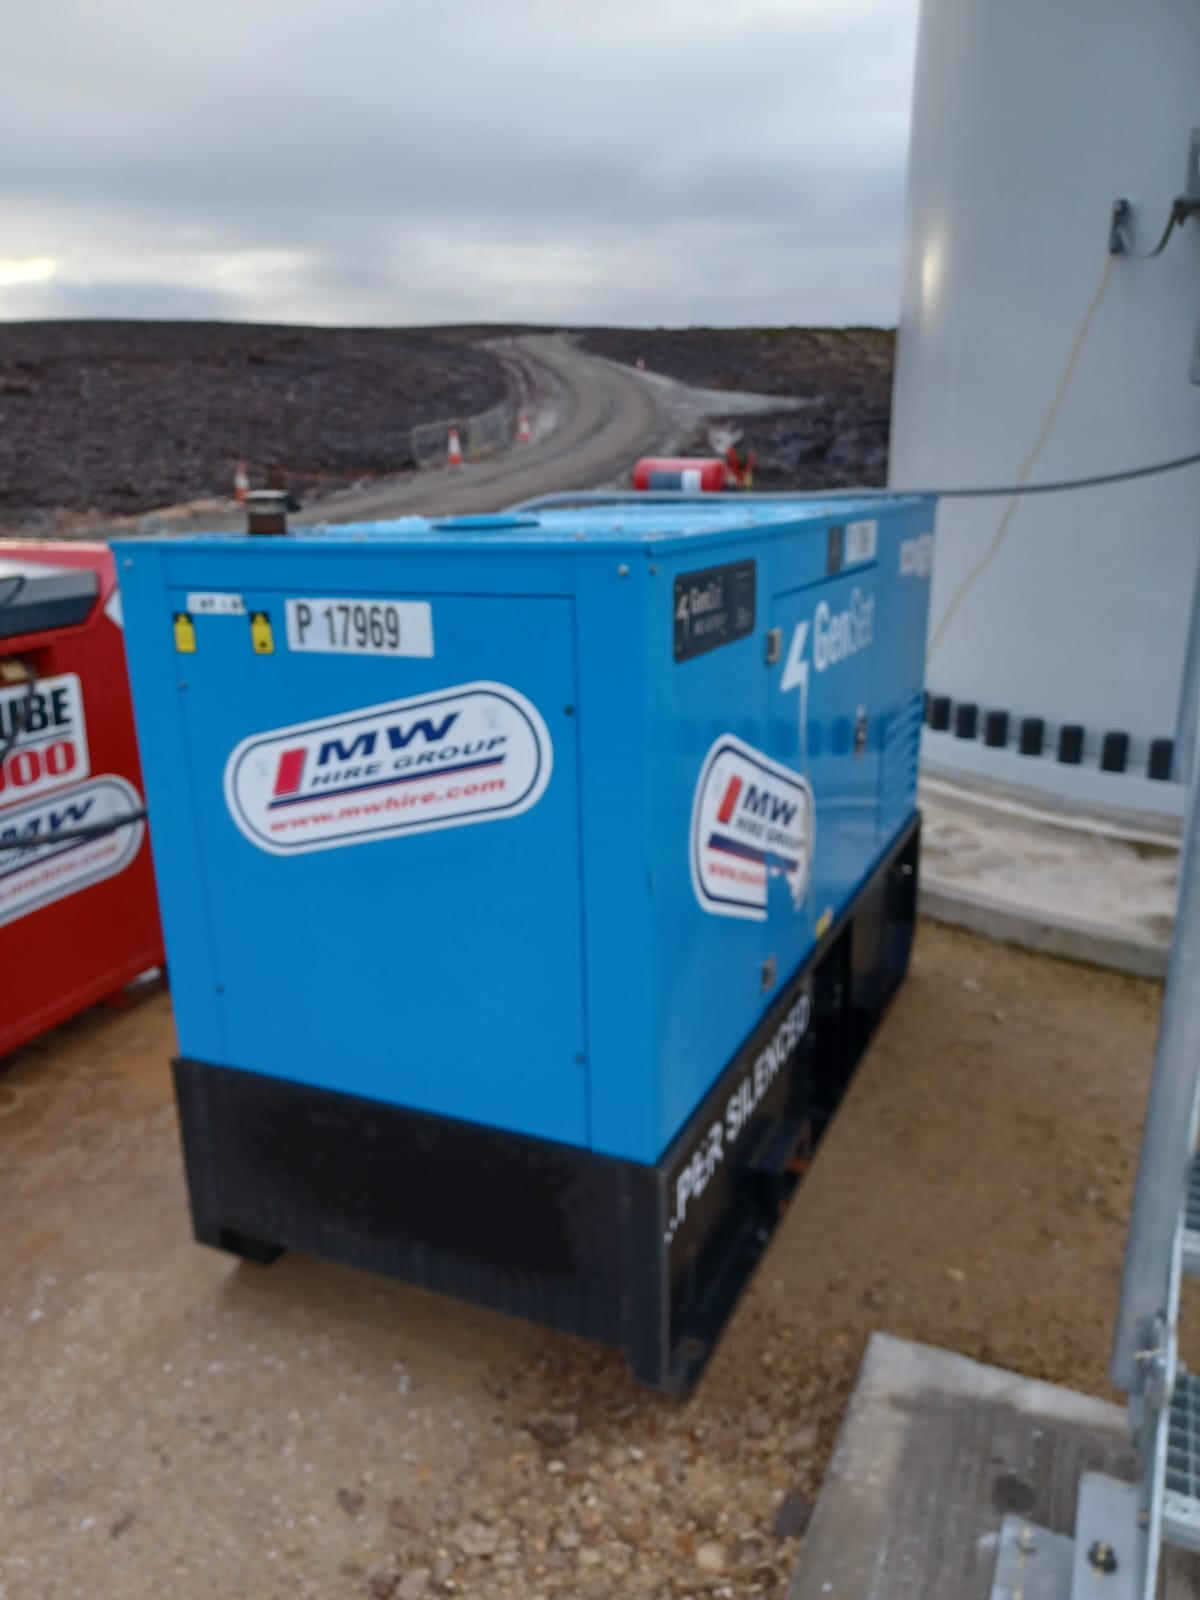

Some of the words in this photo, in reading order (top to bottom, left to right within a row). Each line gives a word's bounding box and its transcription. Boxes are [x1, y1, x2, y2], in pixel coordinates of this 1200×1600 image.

[296, 604, 311, 644] P
[323, 606, 399, 648] 17969
[311, 759, 382, 787] HIRE
[393, 735, 508, 770] GROUP
[317, 710, 461, 767] MW
[0, 739, 76, 792] 00
[269, 779, 506, 833] www.mwhire.com
[743, 783, 798, 827] MW
[726, 993, 811, 1143] SILENCED
